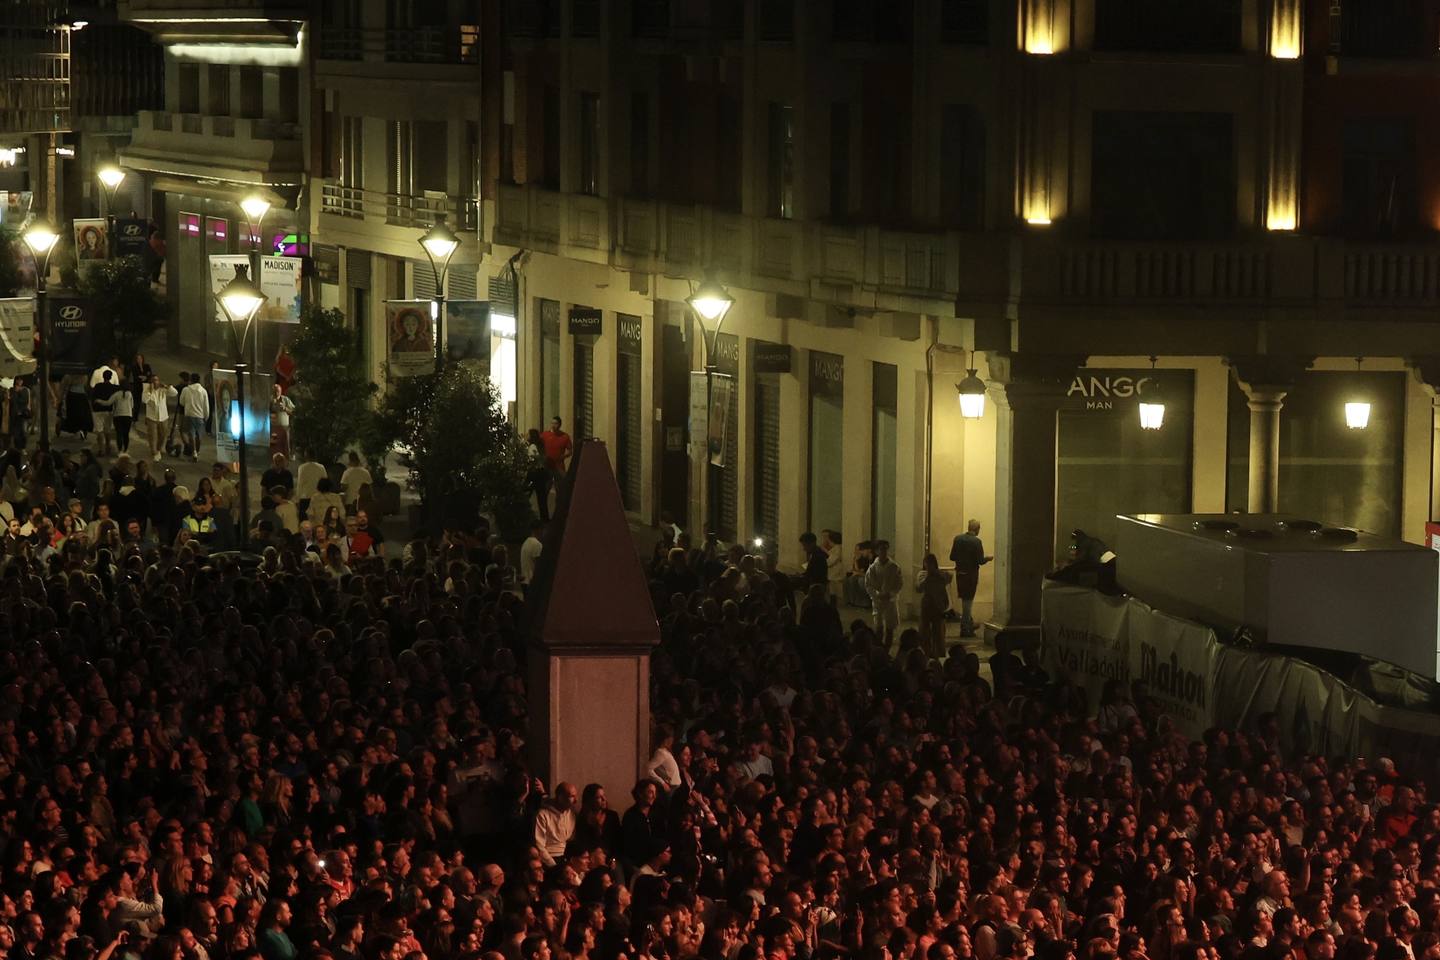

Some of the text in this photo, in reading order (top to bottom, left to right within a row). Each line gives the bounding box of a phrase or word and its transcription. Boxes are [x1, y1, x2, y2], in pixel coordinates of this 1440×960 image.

[264, 260, 294, 271] MADISON
[620, 320, 642, 340] MANG
[717, 342, 738, 361] MANG
[1066, 375, 1154, 398] ANG
[1086, 401, 1113, 409] MAN
